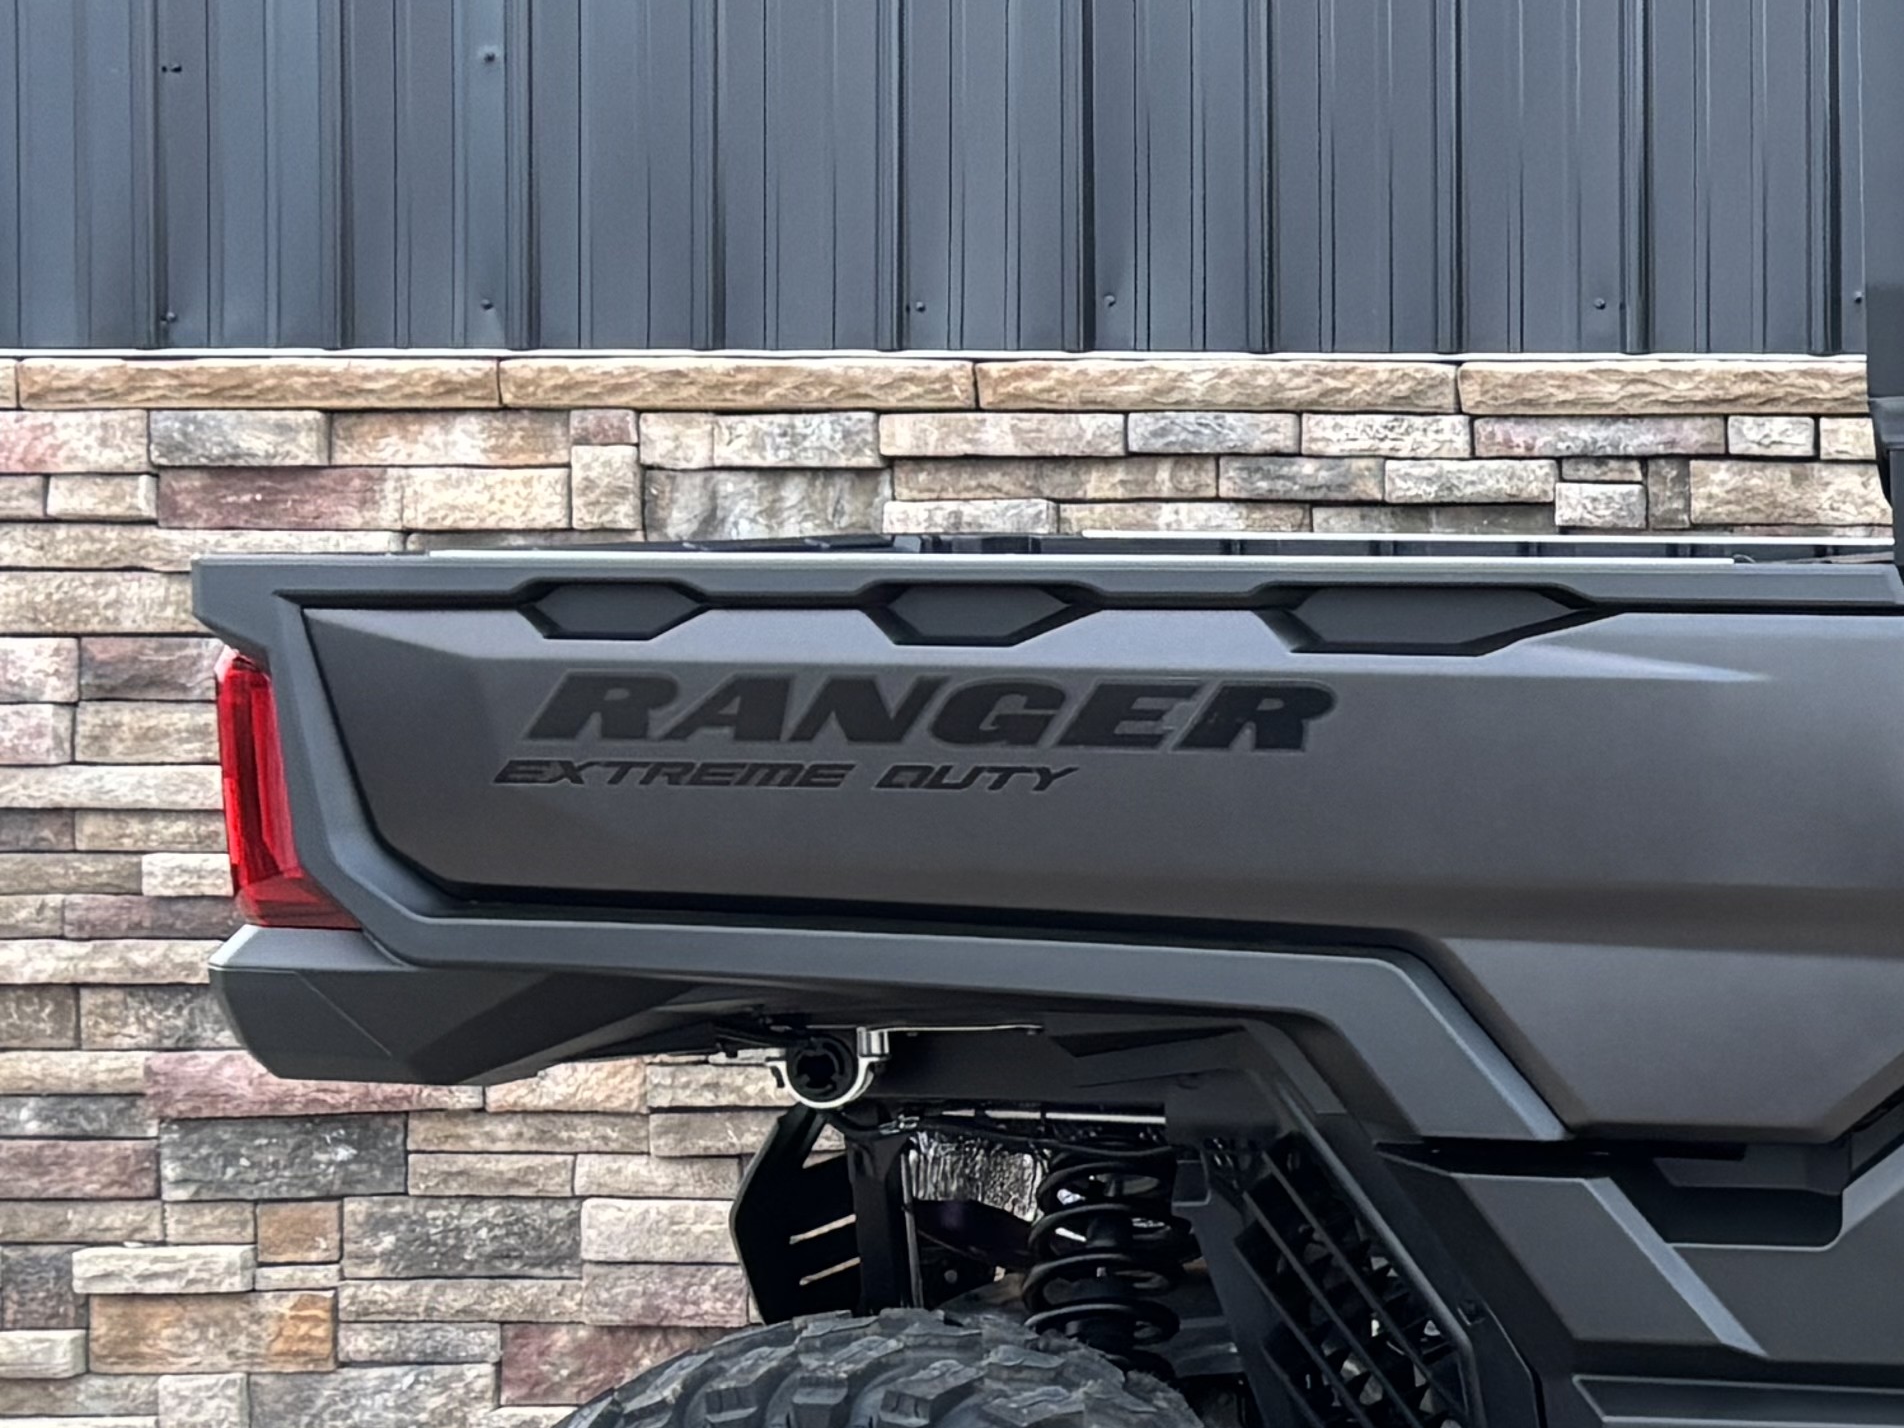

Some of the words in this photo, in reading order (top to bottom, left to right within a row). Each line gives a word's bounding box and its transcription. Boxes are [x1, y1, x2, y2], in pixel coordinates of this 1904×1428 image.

[524, 672, 1336, 753] RANGER
[494, 758, 857, 788] EXTREME
[875, 764, 1078, 792] DUTY
